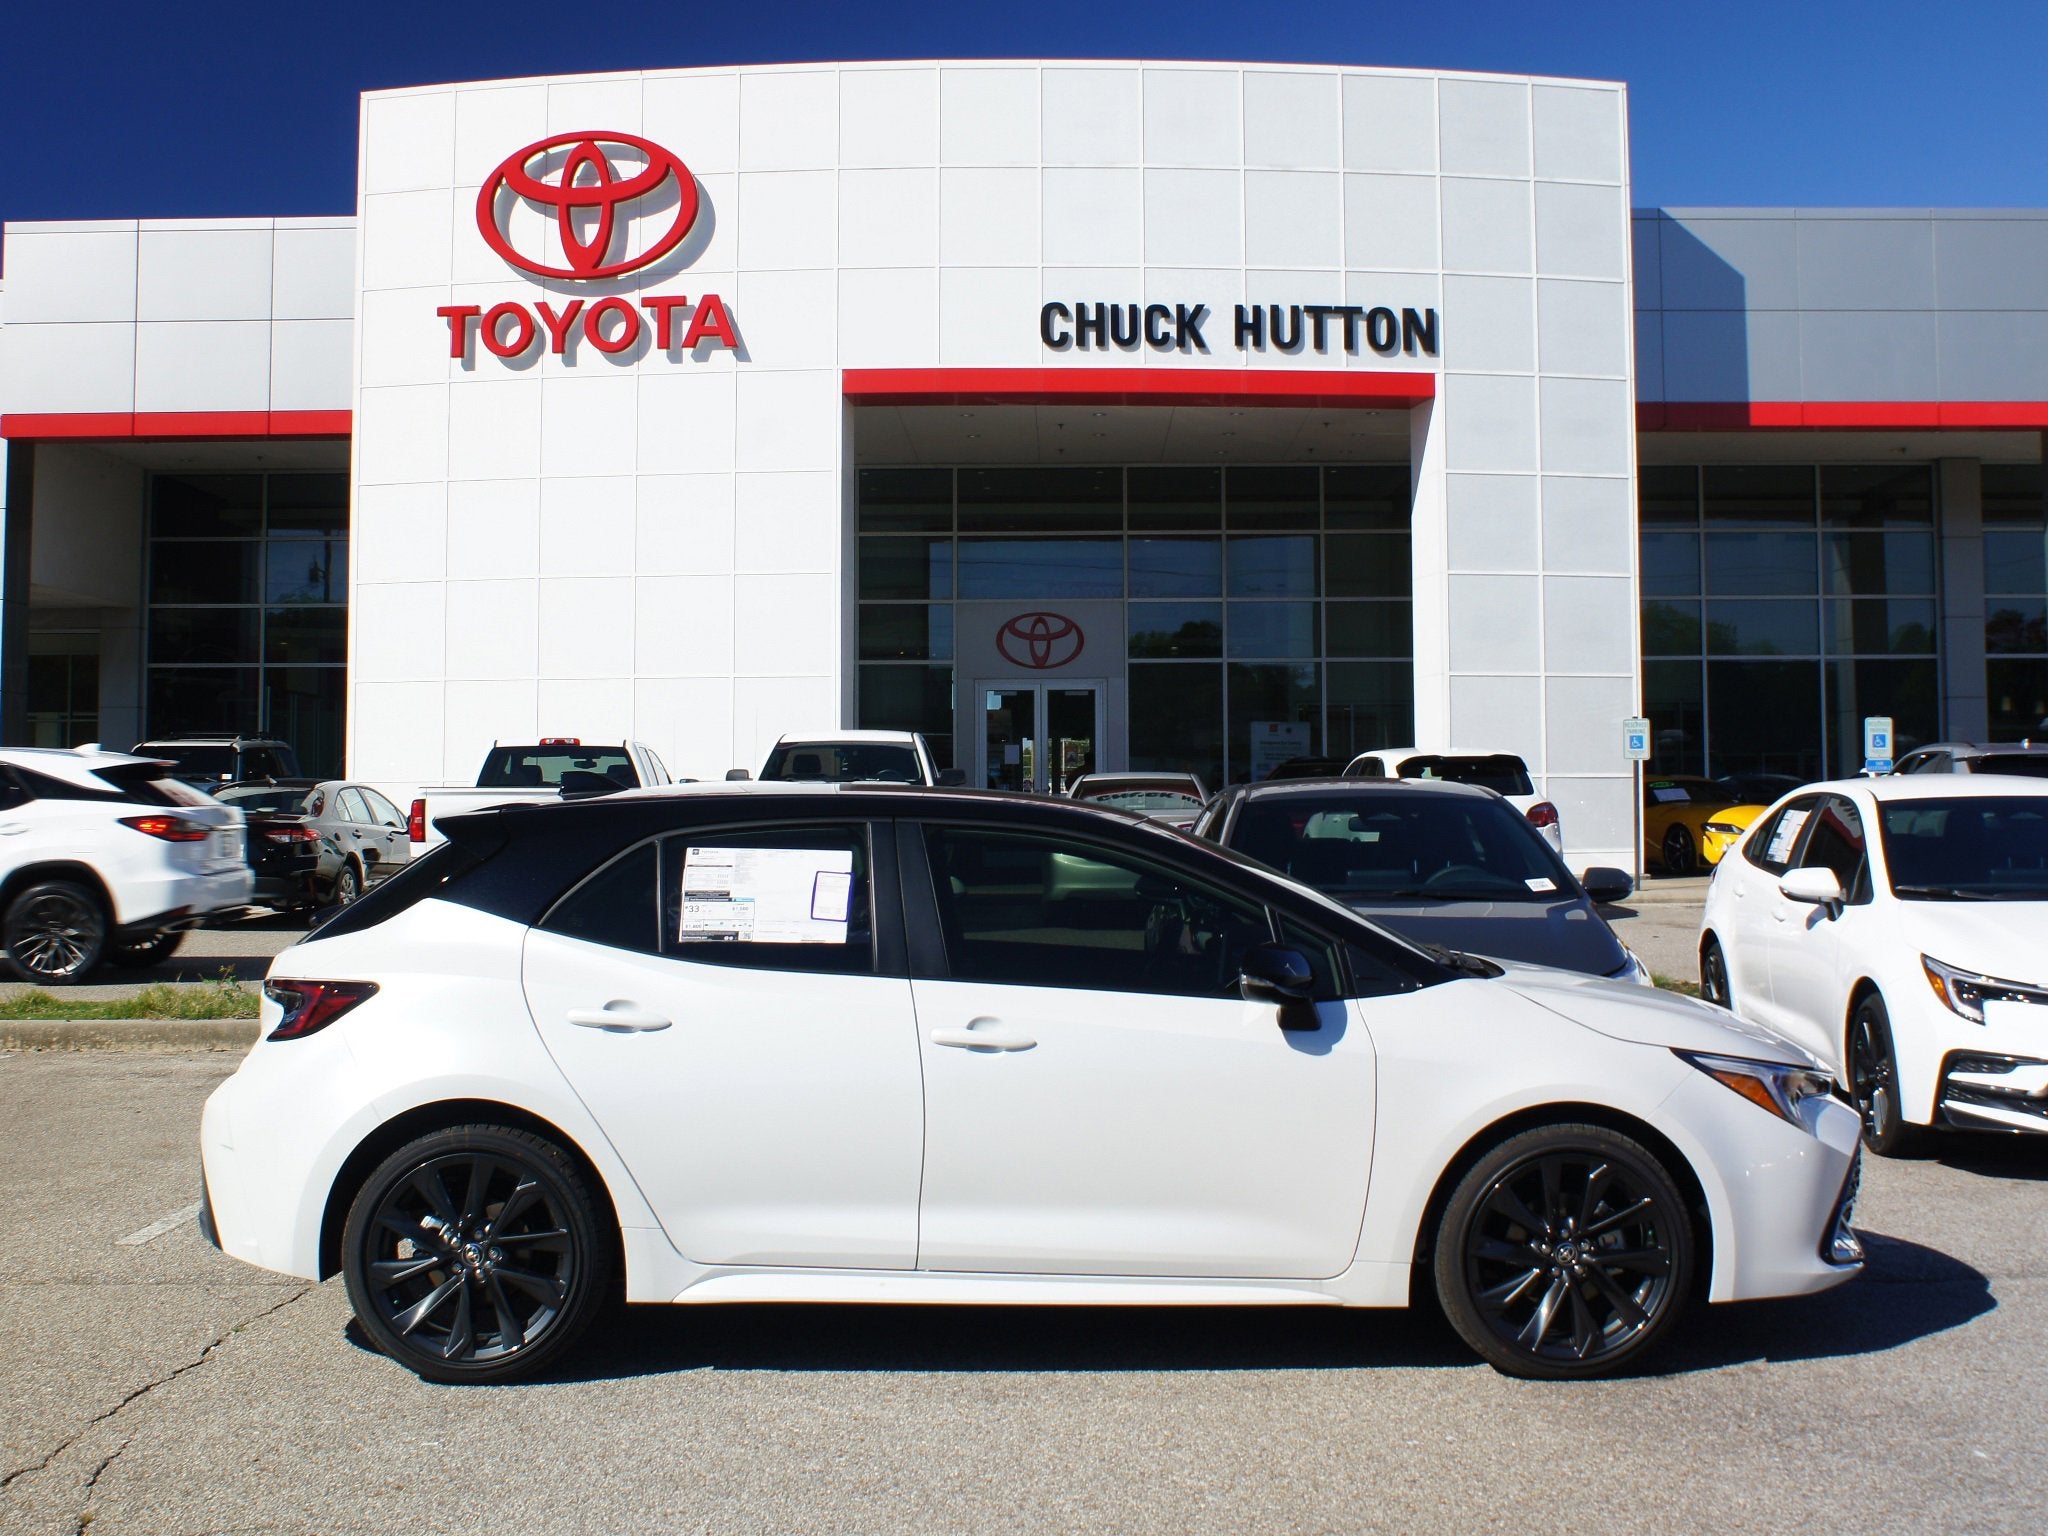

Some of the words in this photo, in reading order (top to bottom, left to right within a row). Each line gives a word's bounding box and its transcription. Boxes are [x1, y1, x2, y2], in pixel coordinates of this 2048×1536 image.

[436, 293, 740, 359] TOYOTA
[1040, 301, 1209, 349] CHUCK
[1233, 304, 1437, 354] HUTTON
